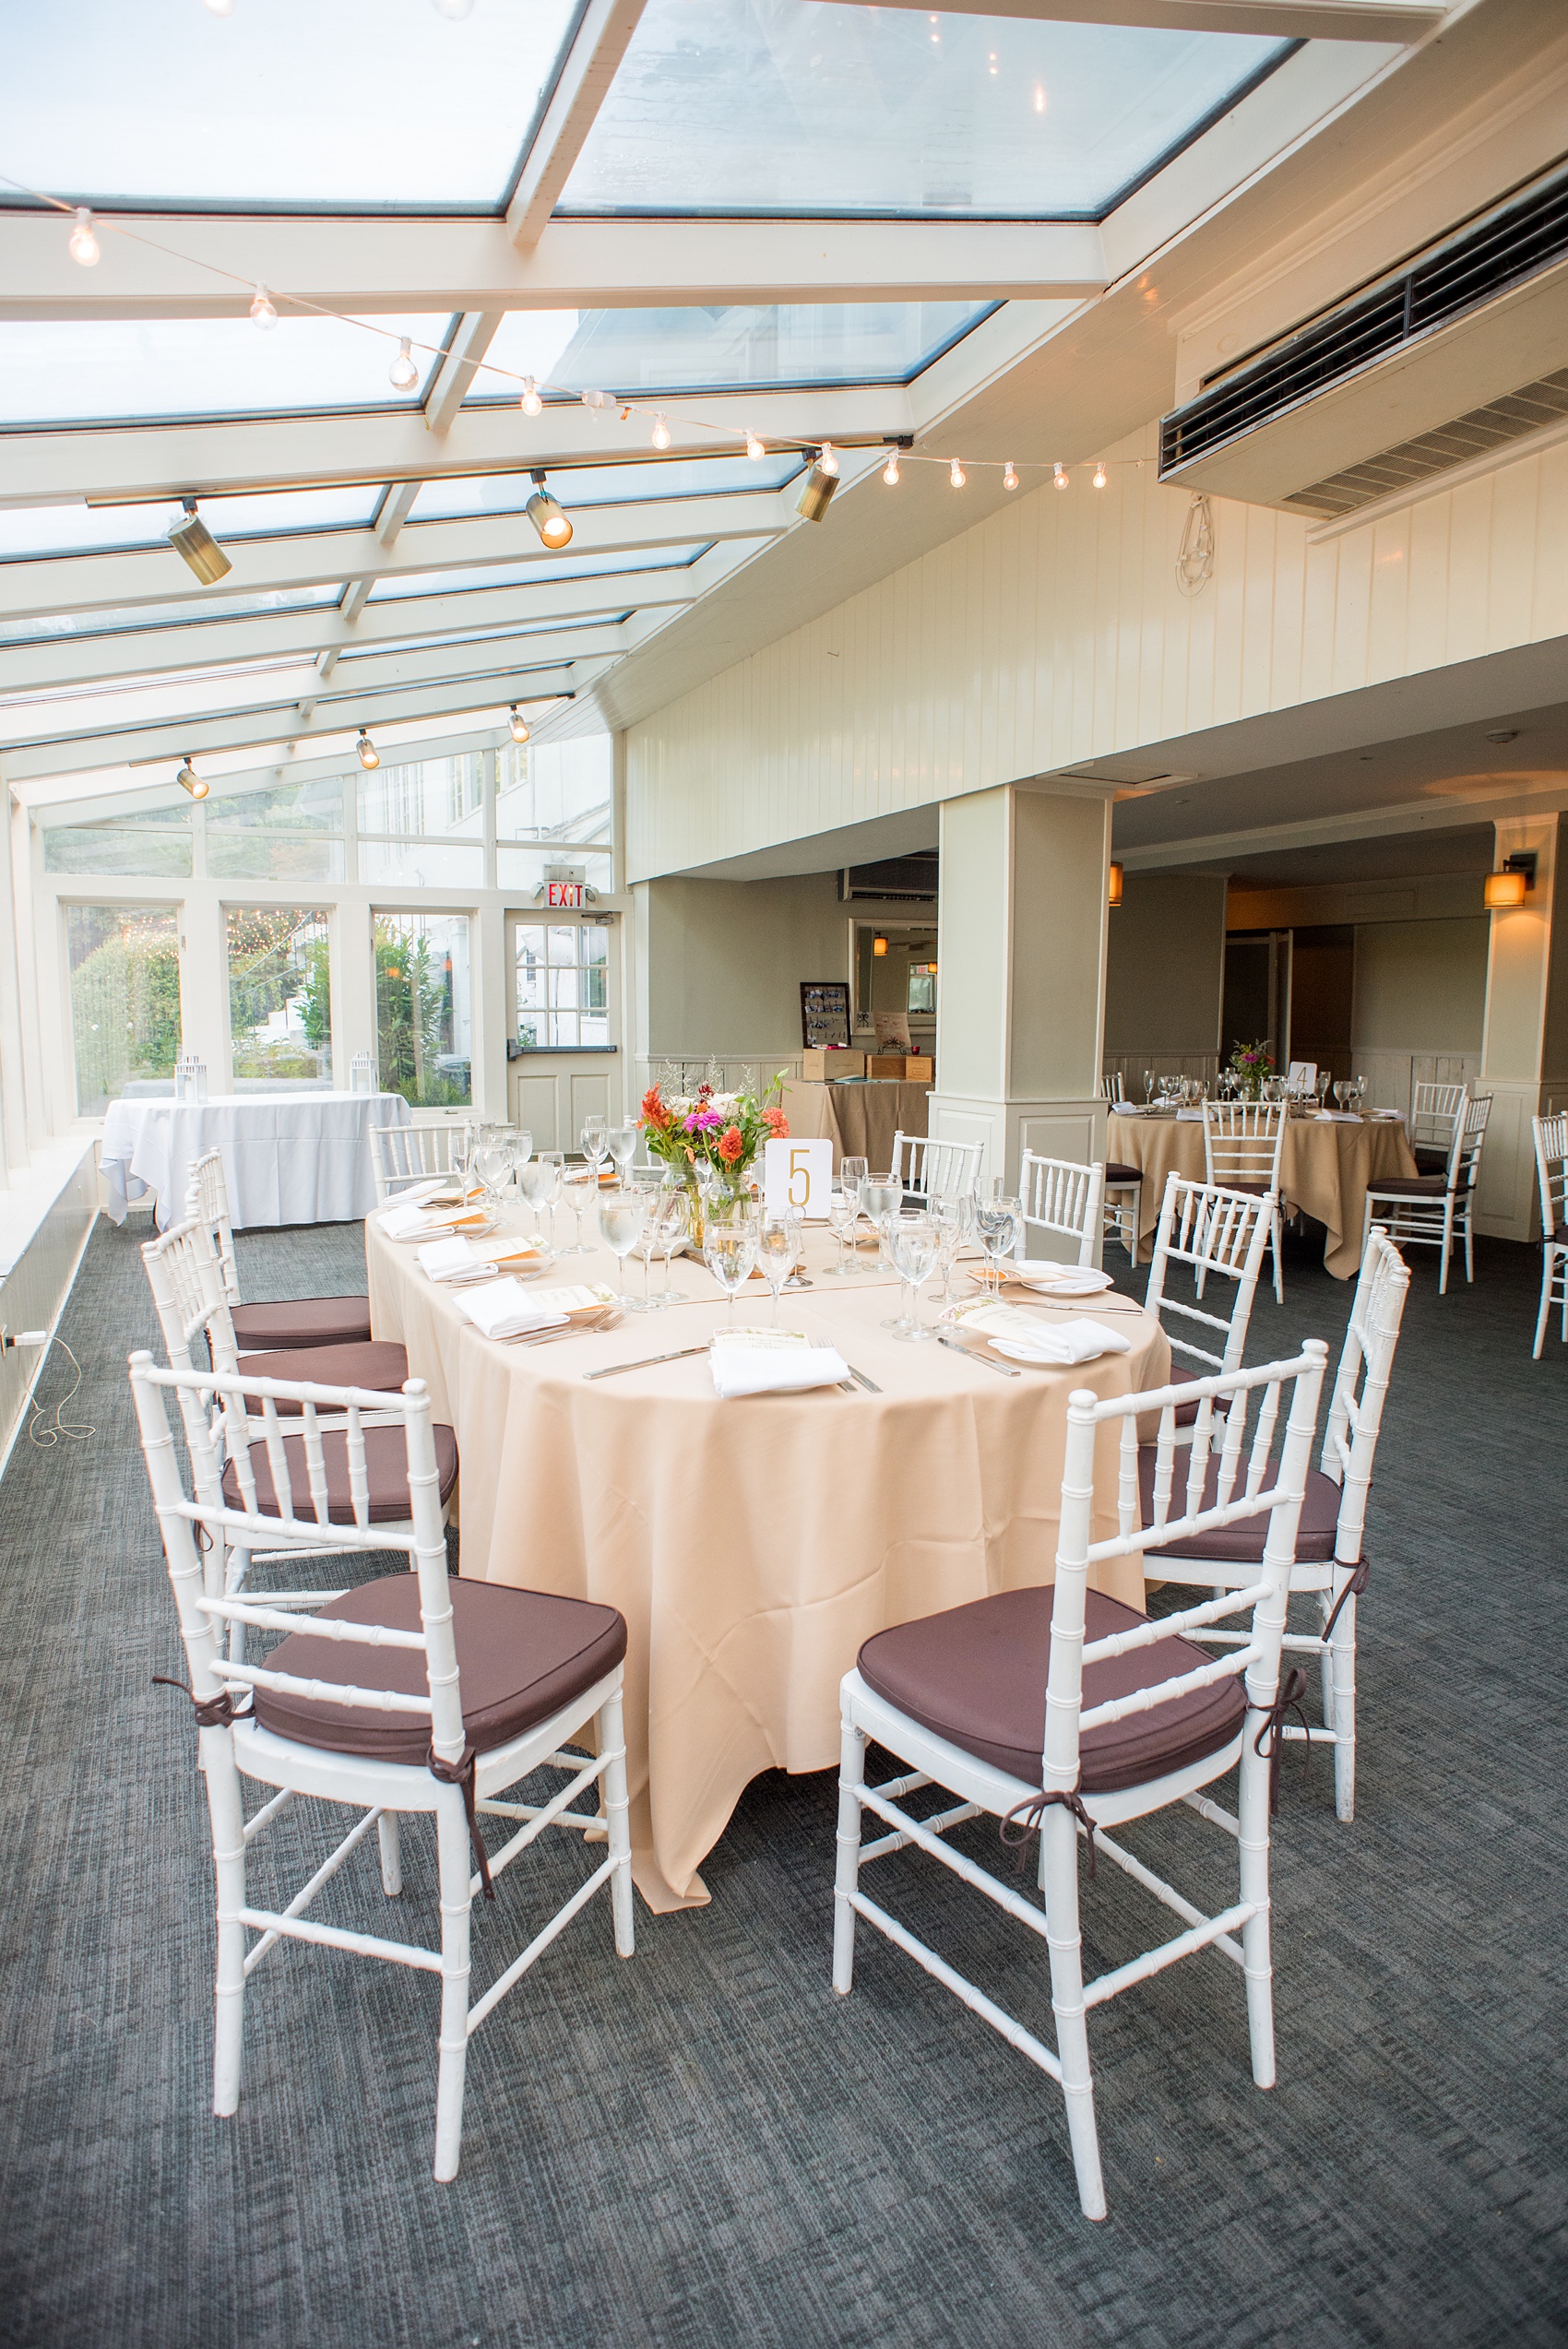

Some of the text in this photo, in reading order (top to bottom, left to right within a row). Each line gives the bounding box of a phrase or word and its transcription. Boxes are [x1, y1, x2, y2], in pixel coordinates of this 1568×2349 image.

[549, 884, 583, 907] EXIT
[1297, 1066, 1308, 1089] 4
[789, 1148, 810, 1206] 5
